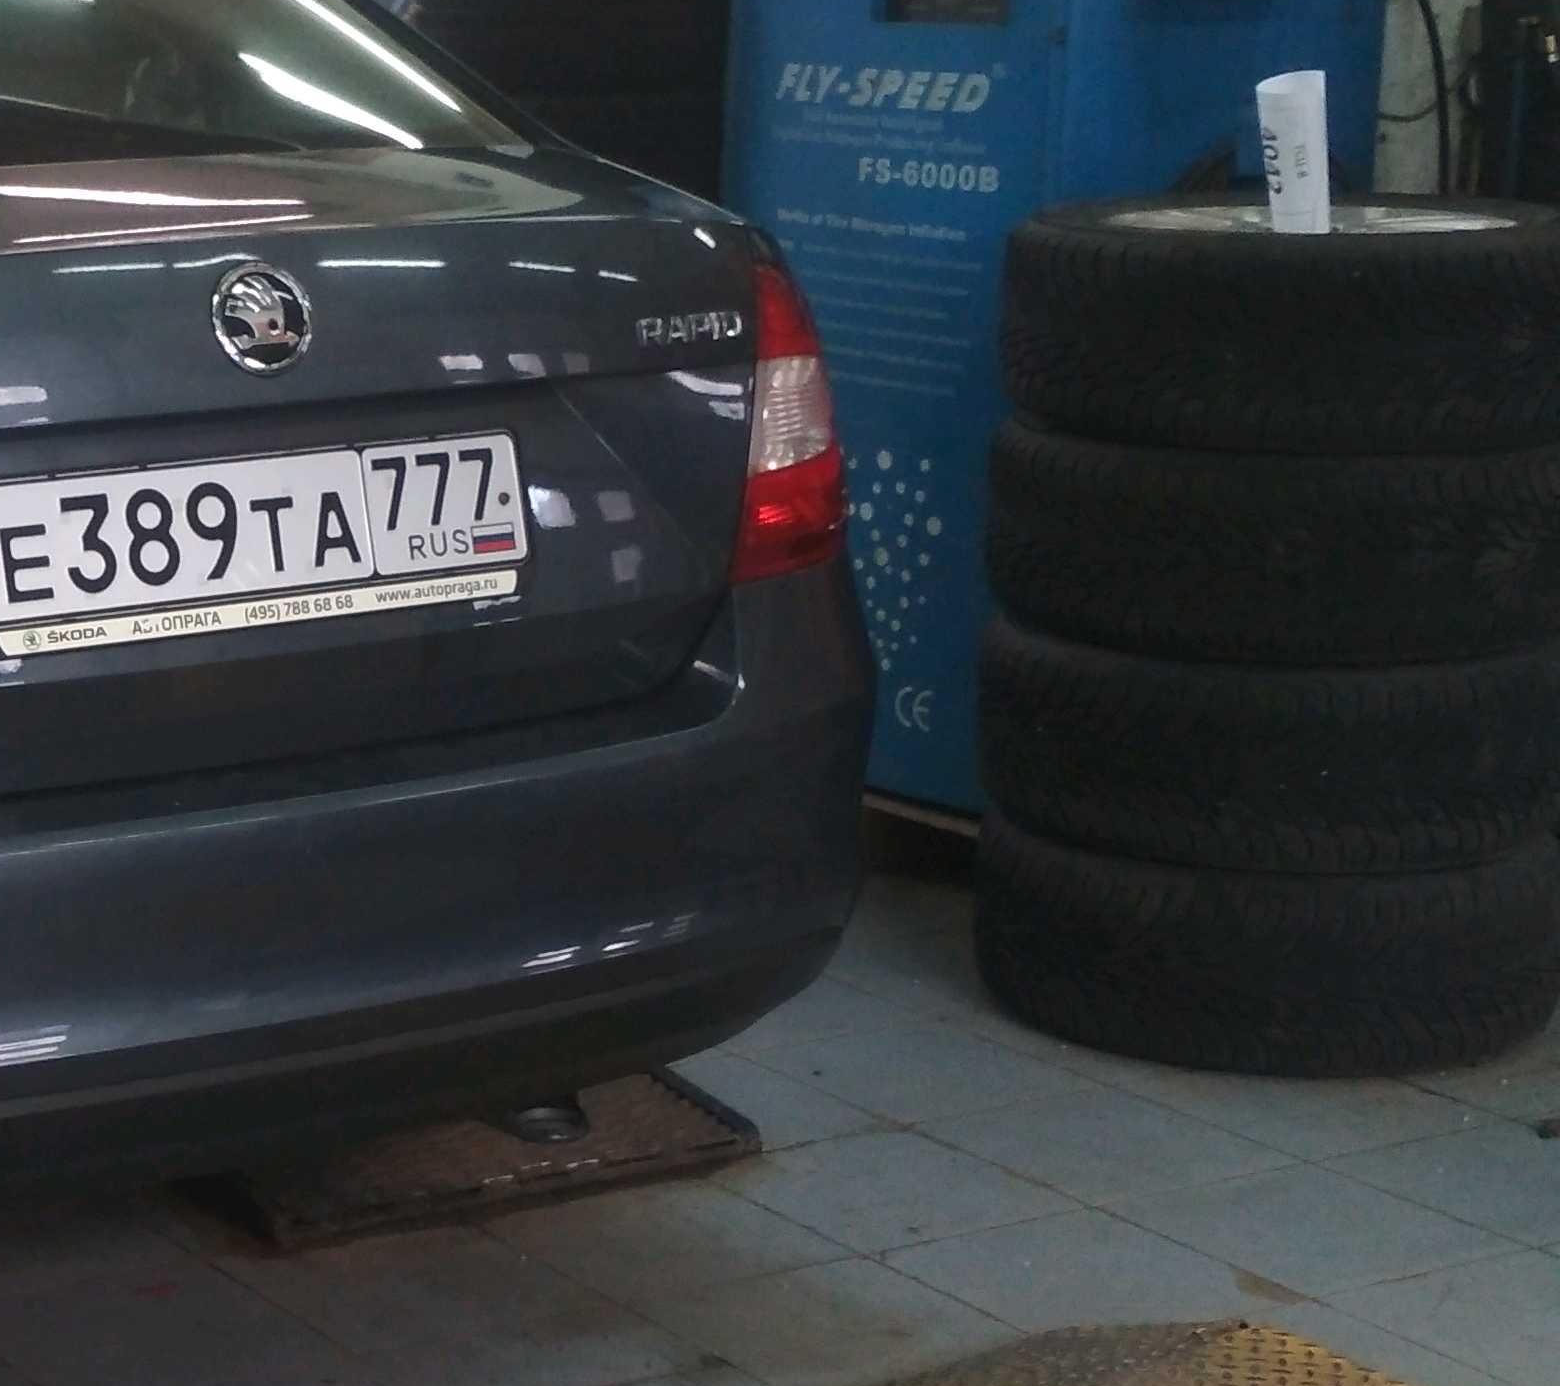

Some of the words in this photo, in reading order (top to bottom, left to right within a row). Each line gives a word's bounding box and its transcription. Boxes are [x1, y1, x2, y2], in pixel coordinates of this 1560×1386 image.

[776, 63, 991, 113] FLY-SPEED
[858, 157, 1000, 193] FS-6000B
[636, 311, 743, 348] RAPID
[0, 481, 362, 605] Е389ТА
[371, 449, 494, 532] 777
[407, 530, 471, 561] RUS
[47, 626, 108, 644] ŠKODA
[132, 610, 222, 635] АОПРАГА
[245, 605, 281, 624] (495)
[284, 601, 310, 617] 788
[313, 598, 332, 613] 68
[335, 594, 354, 610] 68
[375, 577, 499, 604] www.autopraga.ru
